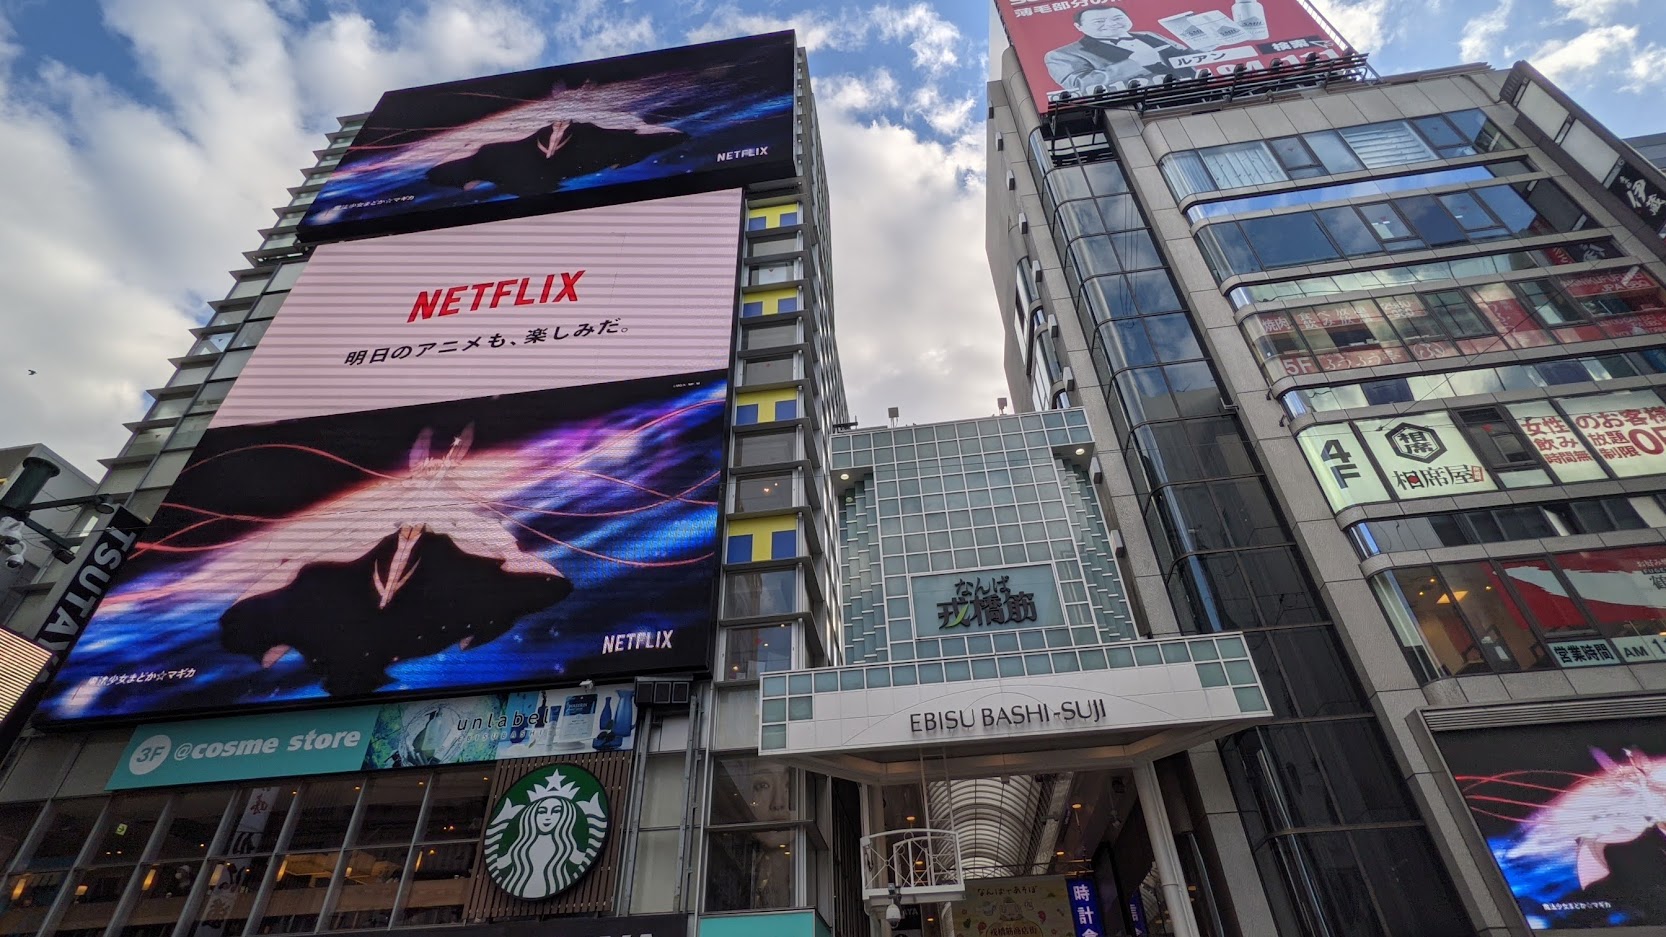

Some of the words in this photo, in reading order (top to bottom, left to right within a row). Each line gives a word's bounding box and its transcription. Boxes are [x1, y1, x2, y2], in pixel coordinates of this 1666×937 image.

[1271, 38, 1310, 52] 検索
[1177, 52, 1226, 67] ルアン
[716, 146, 768, 162] NETFLIX
[406, 270, 586, 323] NETFLIX
[1262, 316, 1292, 333] 焼肉
[344, 317, 629, 366] 明日のアニメも、楽しみだ。
[1282, 356, 1313, 376] 5F
[1398, 431, 1435, 455] 相席
[1533, 430, 1631, 451] 飲み放題
[1320, 439, 1362, 490] 4F
[1544, 445, 1642, 465] 時間無制限
[1391, 464, 1479, 491] 相席屋
[954, 575, 1011, 597] なんば
[36, 525, 137, 684] TSUTAY
[936, 591, 1038, 630] 戎橋筋
[602, 629, 674, 655] NETFLIX
[1553, 642, 1615, 664] 営業時間
[1623, 645, 1649, 658] AM
[457, 709, 550, 732] unlabel
[910, 708, 975, 733] EBISU
[981, 698, 1107, 727] BASHI-SUJI
[136, 746, 165, 763] 3F
[173, 737, 276, 761] @cosme
[287, 728, 361, 751] store
